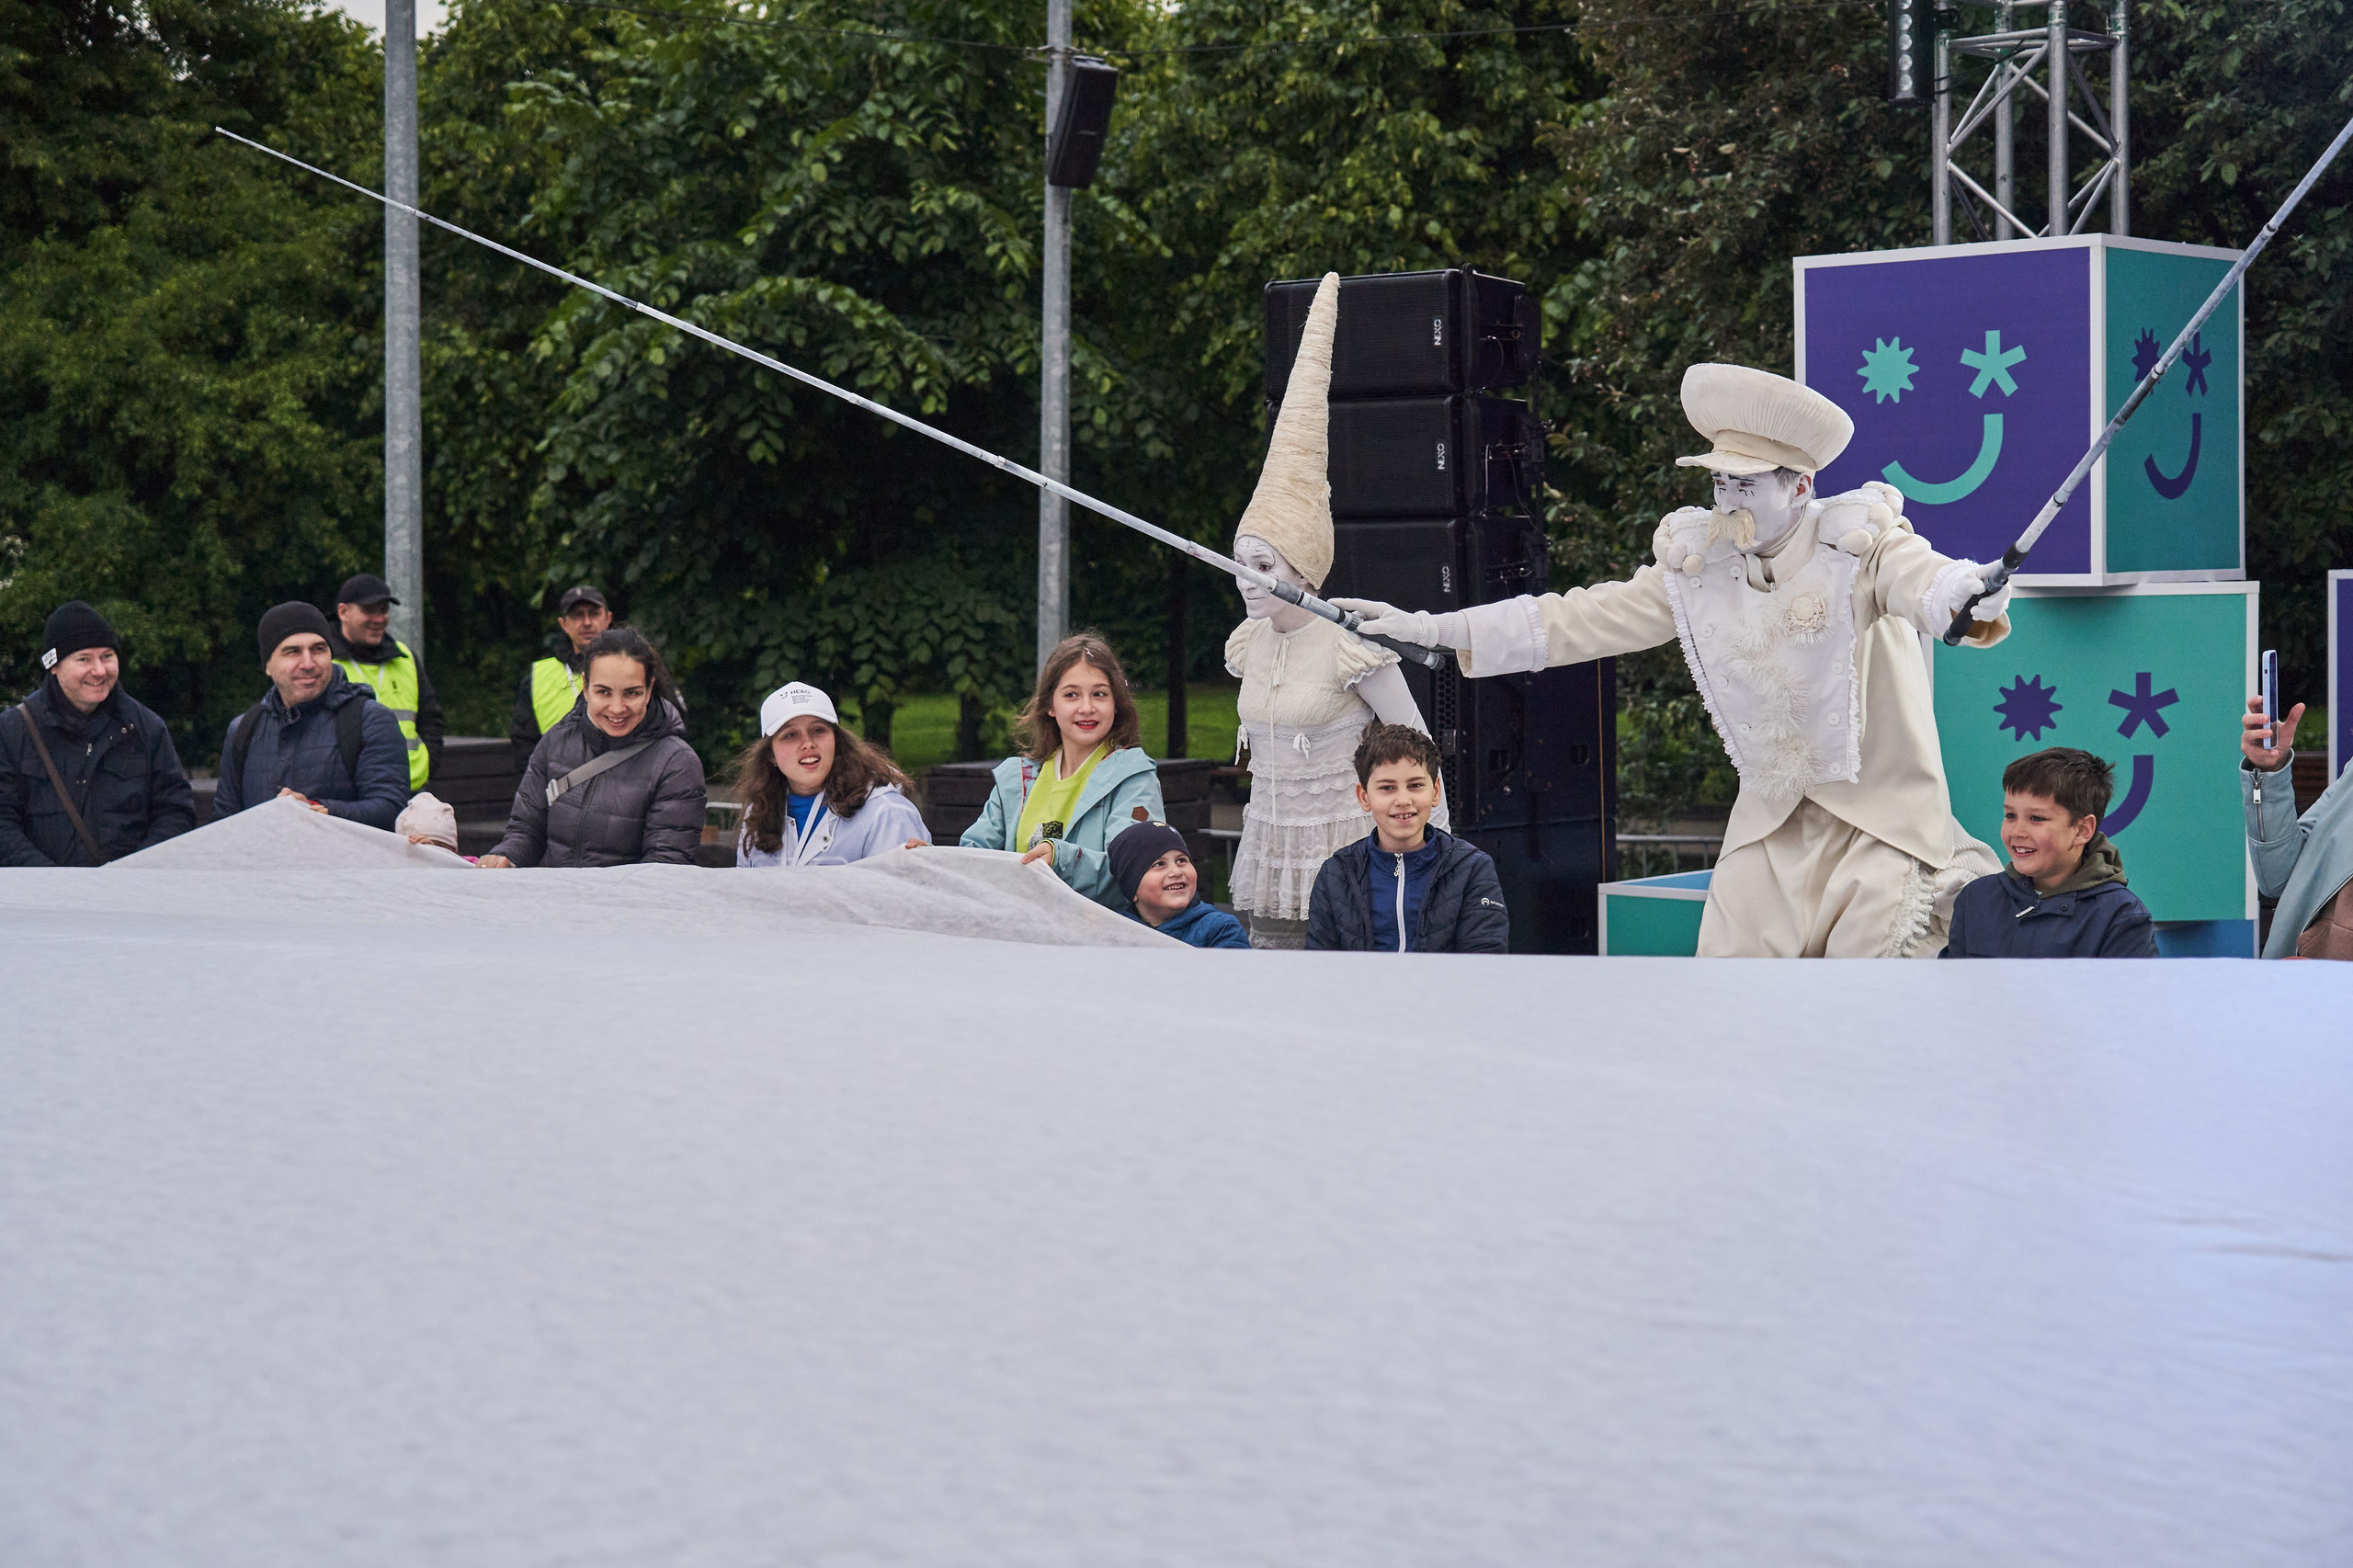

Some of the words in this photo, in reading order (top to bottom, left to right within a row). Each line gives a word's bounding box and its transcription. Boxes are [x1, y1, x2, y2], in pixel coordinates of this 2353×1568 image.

[1434, 318, 1442, 346] NEXO
[1437, 443, 1445, 471] NEXO
[1442, 565, 1450, 593] NEXO
